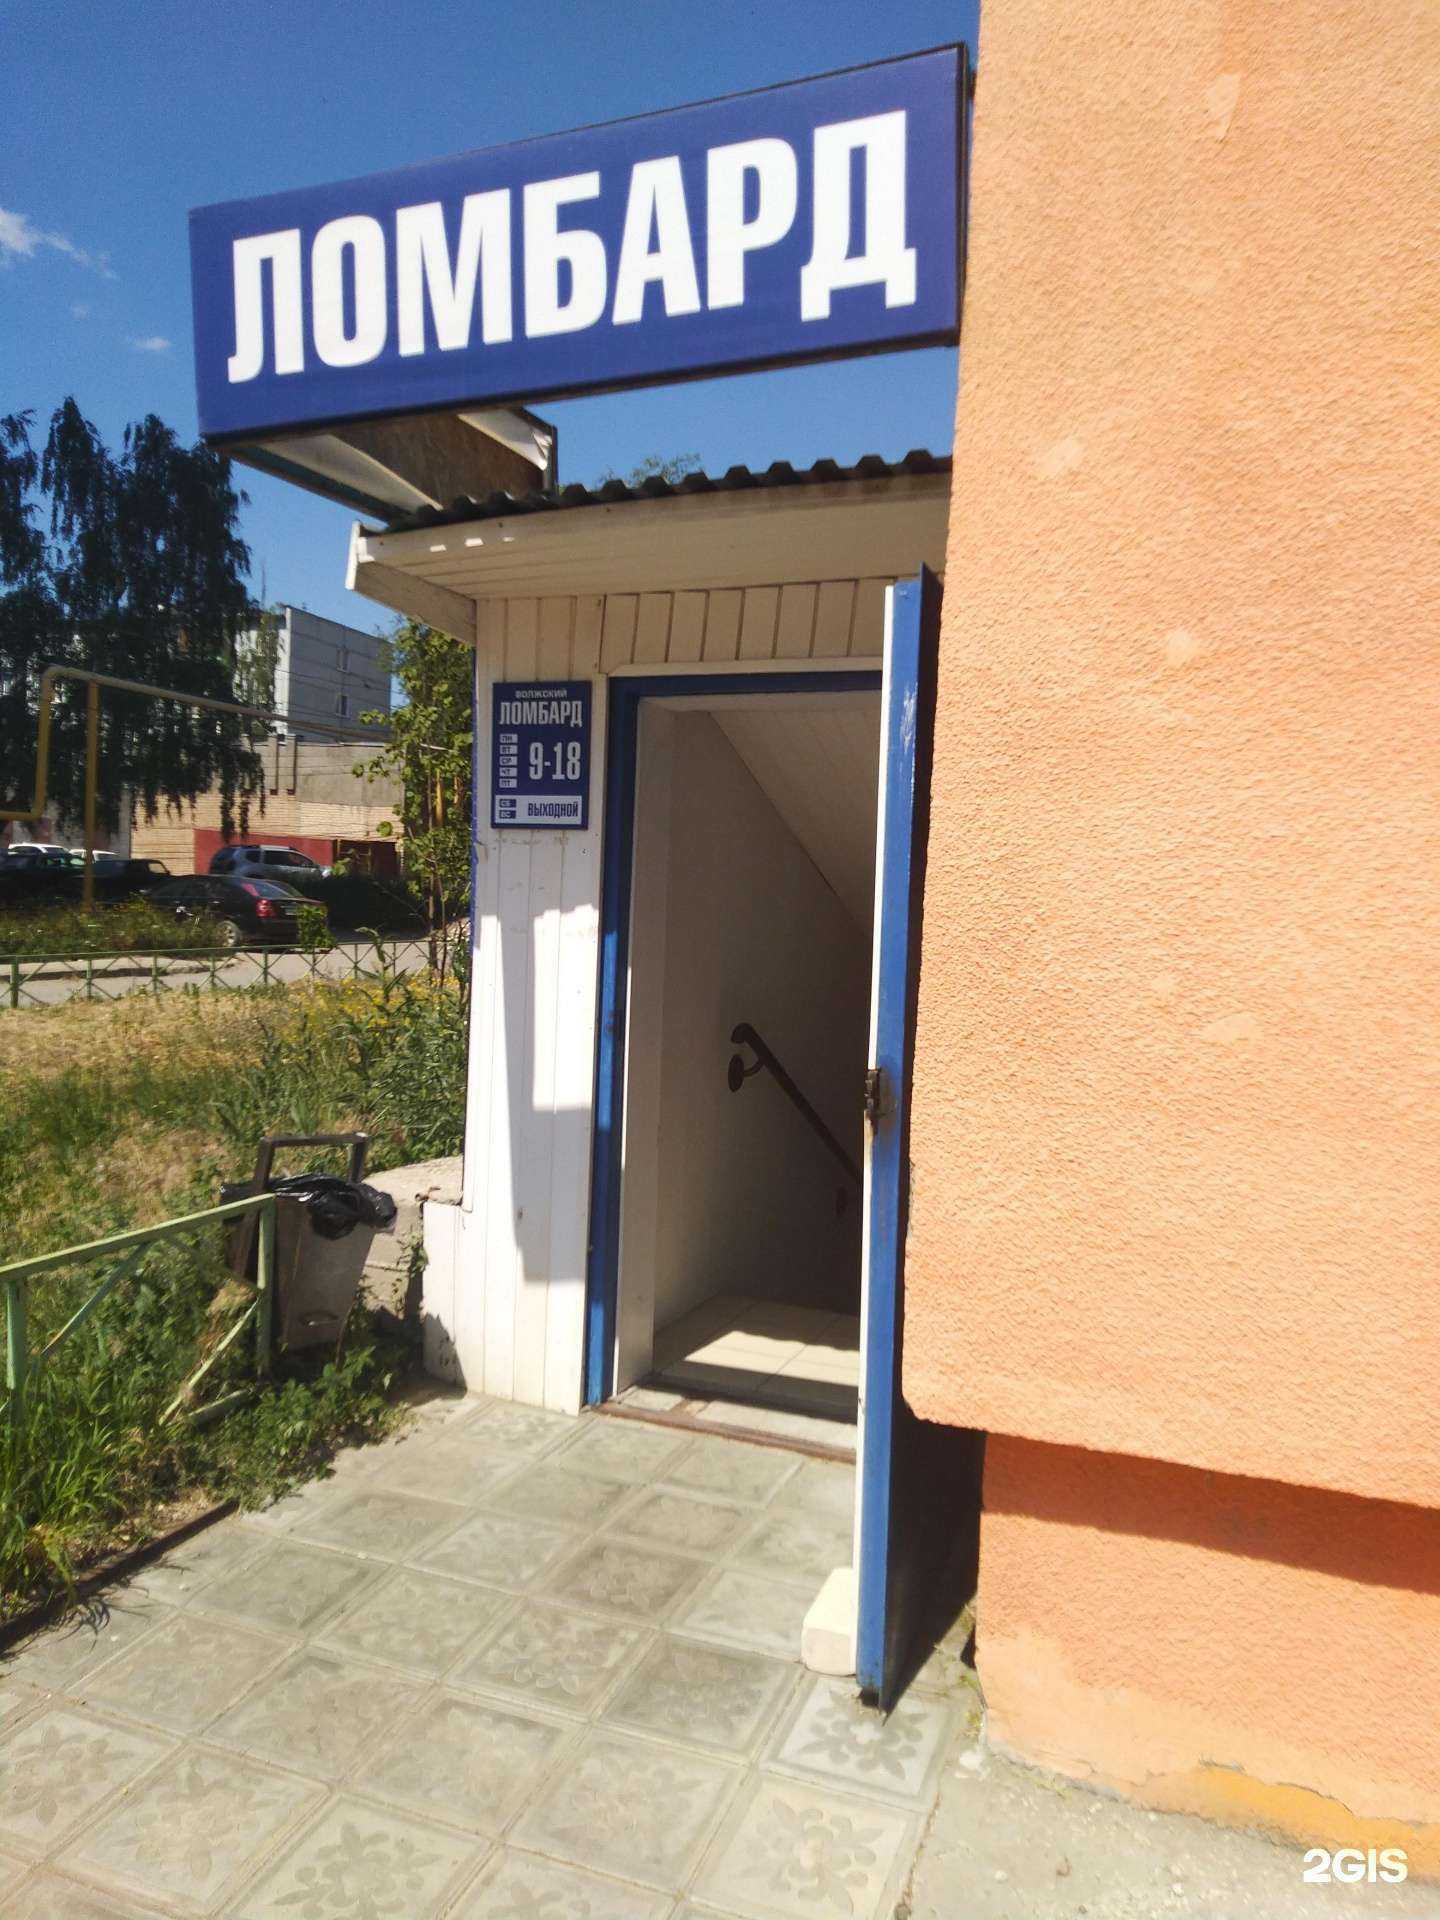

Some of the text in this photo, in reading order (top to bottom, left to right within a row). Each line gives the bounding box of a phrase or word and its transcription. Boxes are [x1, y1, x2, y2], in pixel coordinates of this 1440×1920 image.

[228, 110, 917, 383] ЛОМБАРД
[499, 701, 582, 727] ЛОМБАРД
[529, 742, 581, 780] 9-18
[528, 802, 579, 818] ВЫХОДНОЙ
